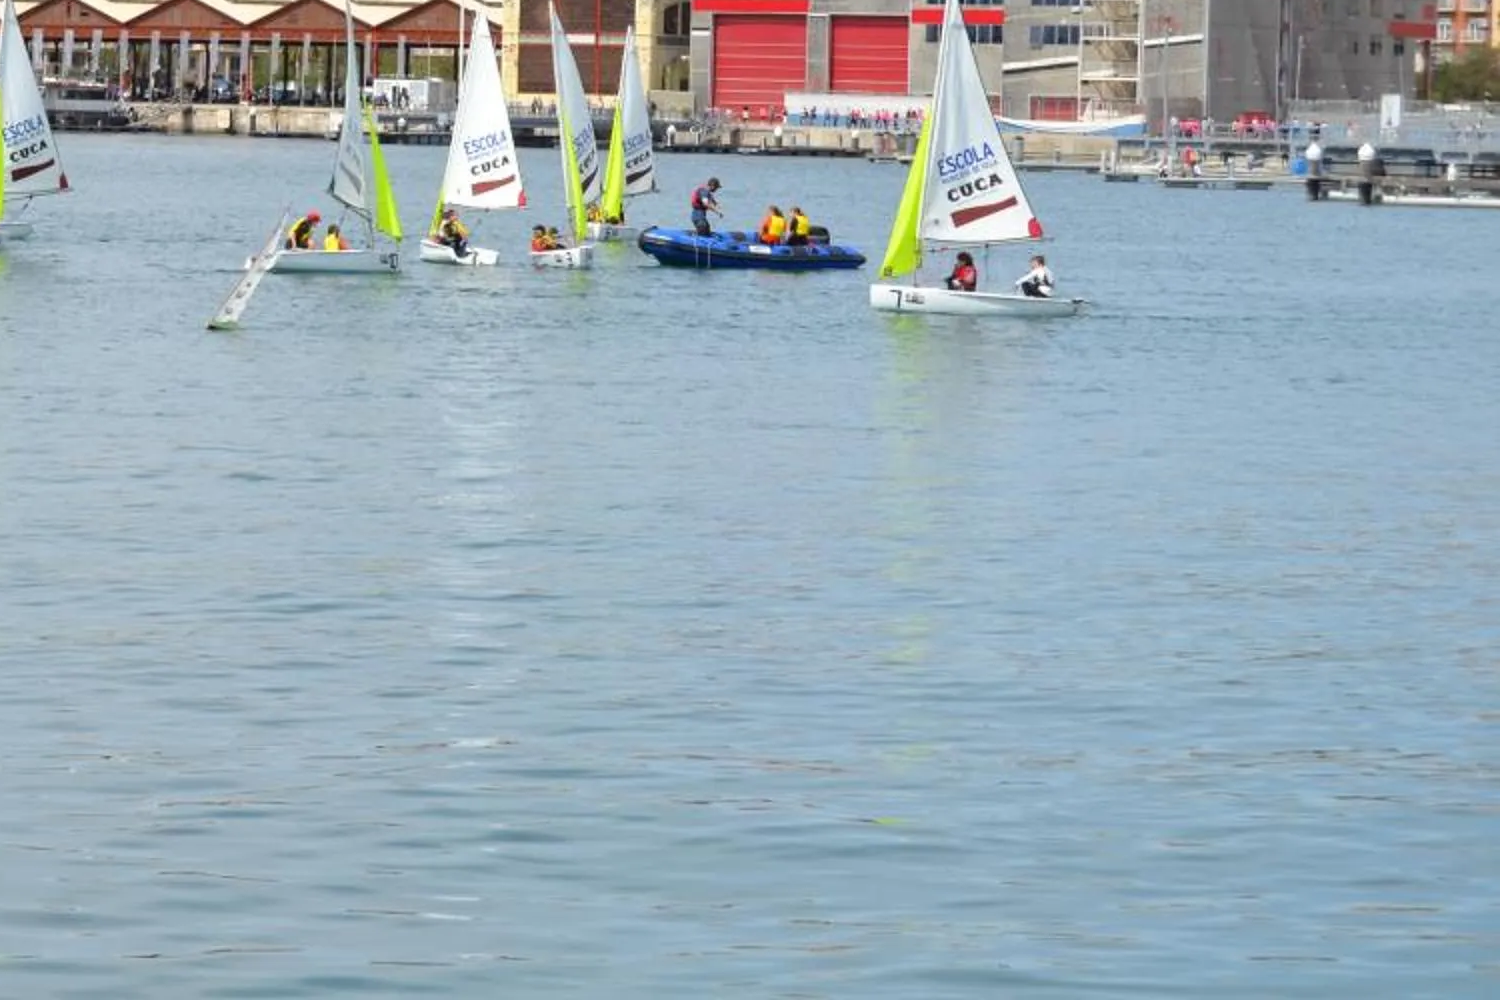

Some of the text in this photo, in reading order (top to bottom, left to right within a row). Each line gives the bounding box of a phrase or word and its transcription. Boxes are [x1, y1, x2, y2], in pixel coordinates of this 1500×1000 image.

[2, 114, 44, 141] ESCOLA
[9, 139, 48, 163] CUCA
[463, 130, 507, 156] ESCOLA
[470, 154, 510, 176] CUCA
[937, 141, 995, 177] ESCOLA
[947, 173, 1003, 203] CUCA
[889, 289, 903, 309] 7
